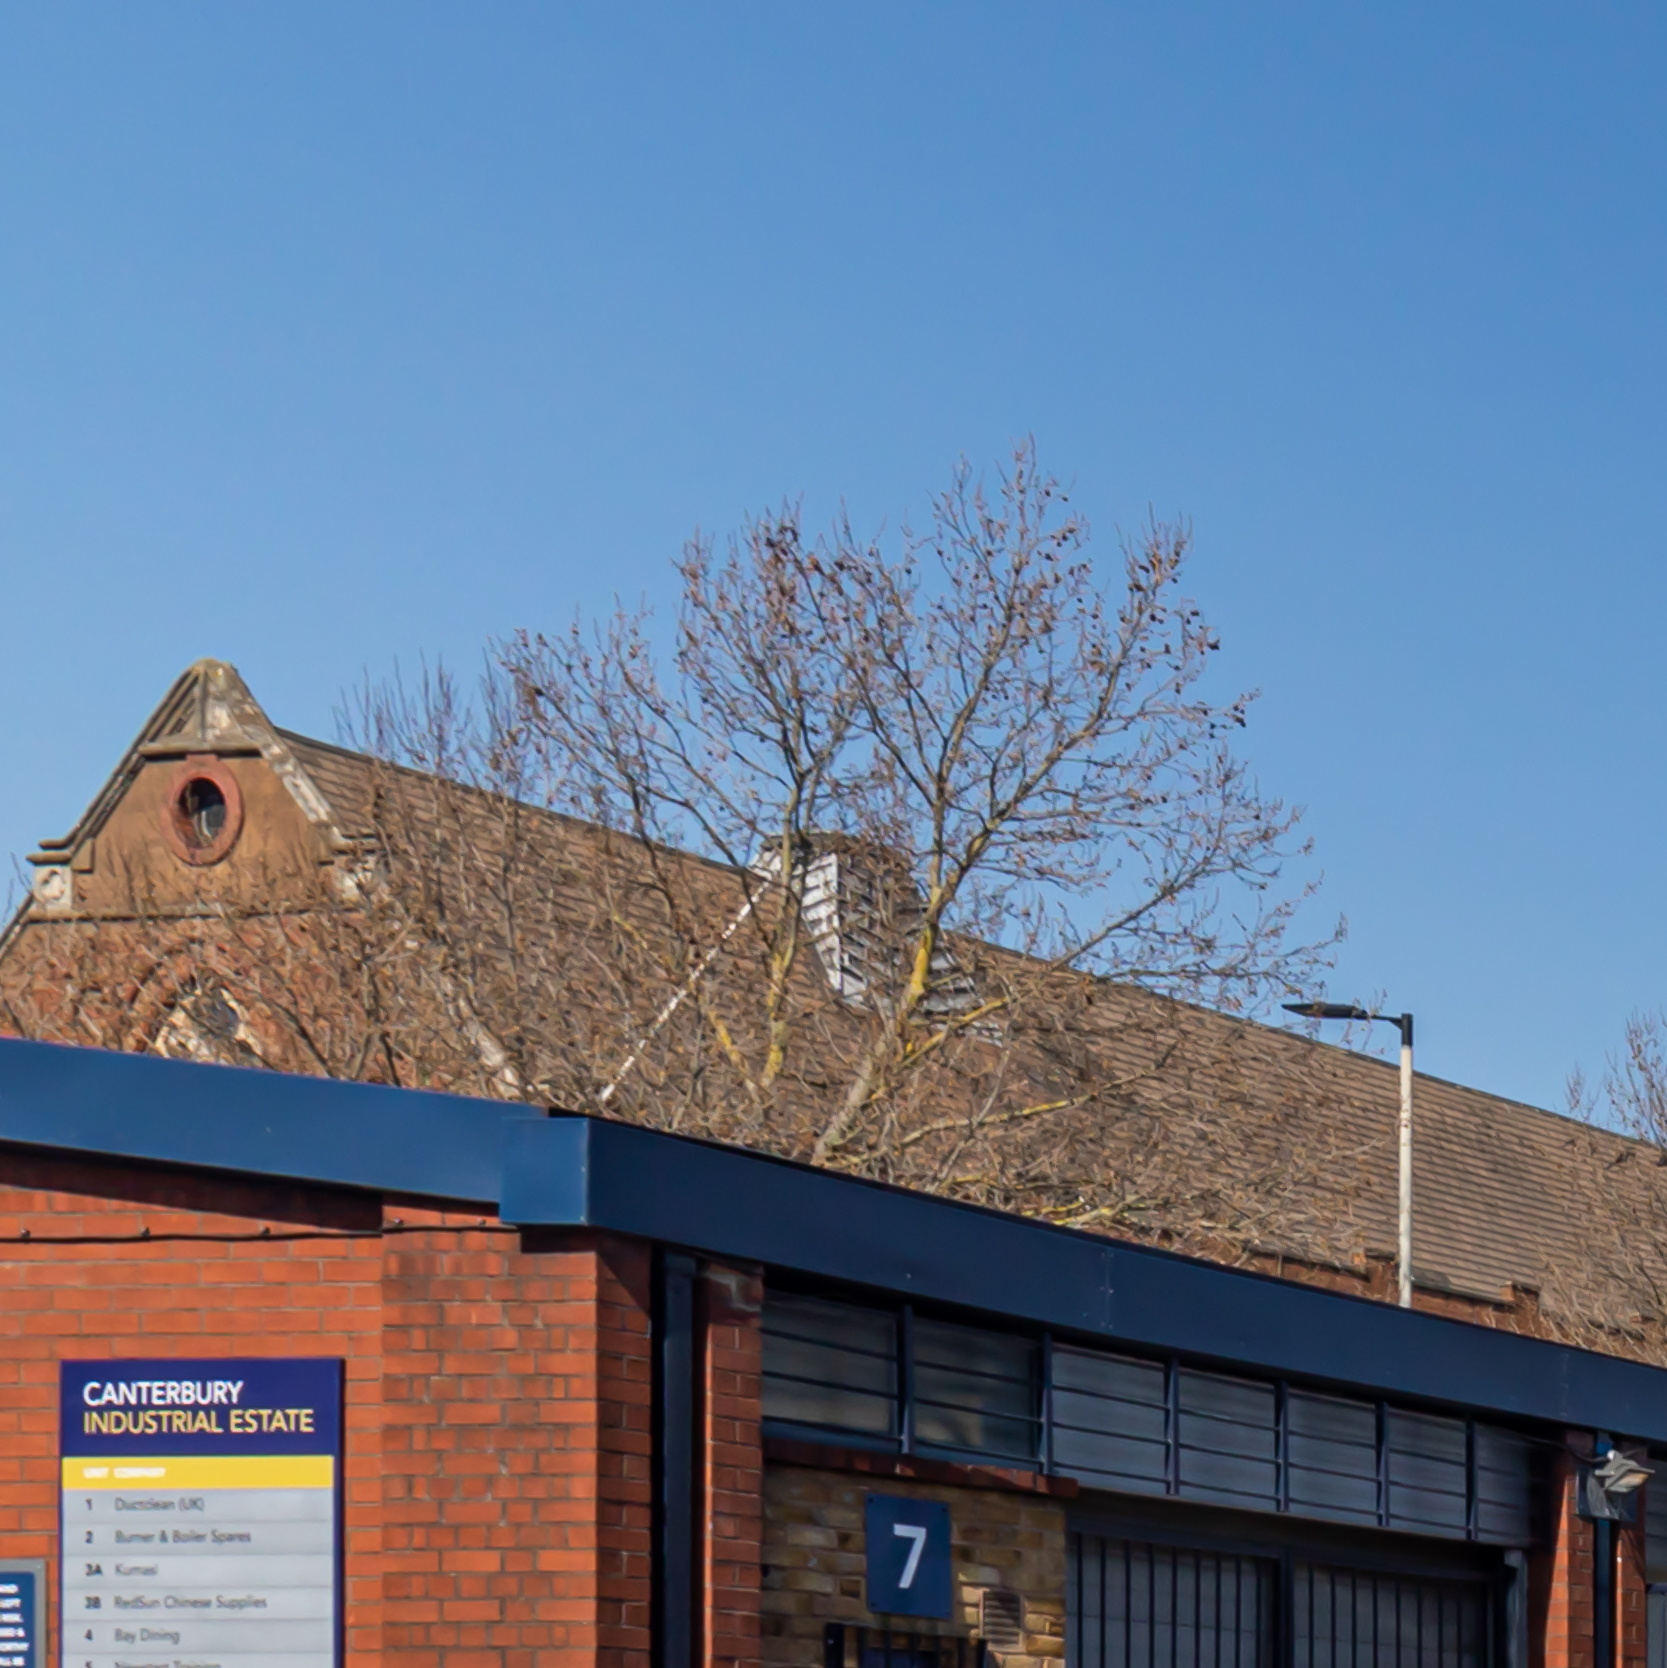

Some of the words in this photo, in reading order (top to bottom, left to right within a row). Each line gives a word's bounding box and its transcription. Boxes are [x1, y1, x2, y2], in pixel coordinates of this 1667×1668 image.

[82, 1380, 244, 1406] CANTERBURY
[83, 1410, 224, 1434] INDUSTRIAL
[230, 1409, 315, 1433] ESTATE
[85, 1498, 92, 1511] 1
[179, 1497, 204, 1512] (UK)
[85, 1530, 93, 1543] 2
[115, 1530, 155, 1543] Burner
[172, 1529, 206, 1543] Boiler
[211, 1529, 251, 1544] Spares
[893, 1523, 927, 1589] 7
[85, 1563, 103, 1576] 3A
[85, 1596, 102, 1609] 3B
[164, 1595, 212, 1608] Chinese
[216, 1594, 267, 1610] Supplies
[84, 1629, 93, 1641] 4
[114, 1628, 136, 1645] Bay
[140, 1628, 180, 1645] Dining
